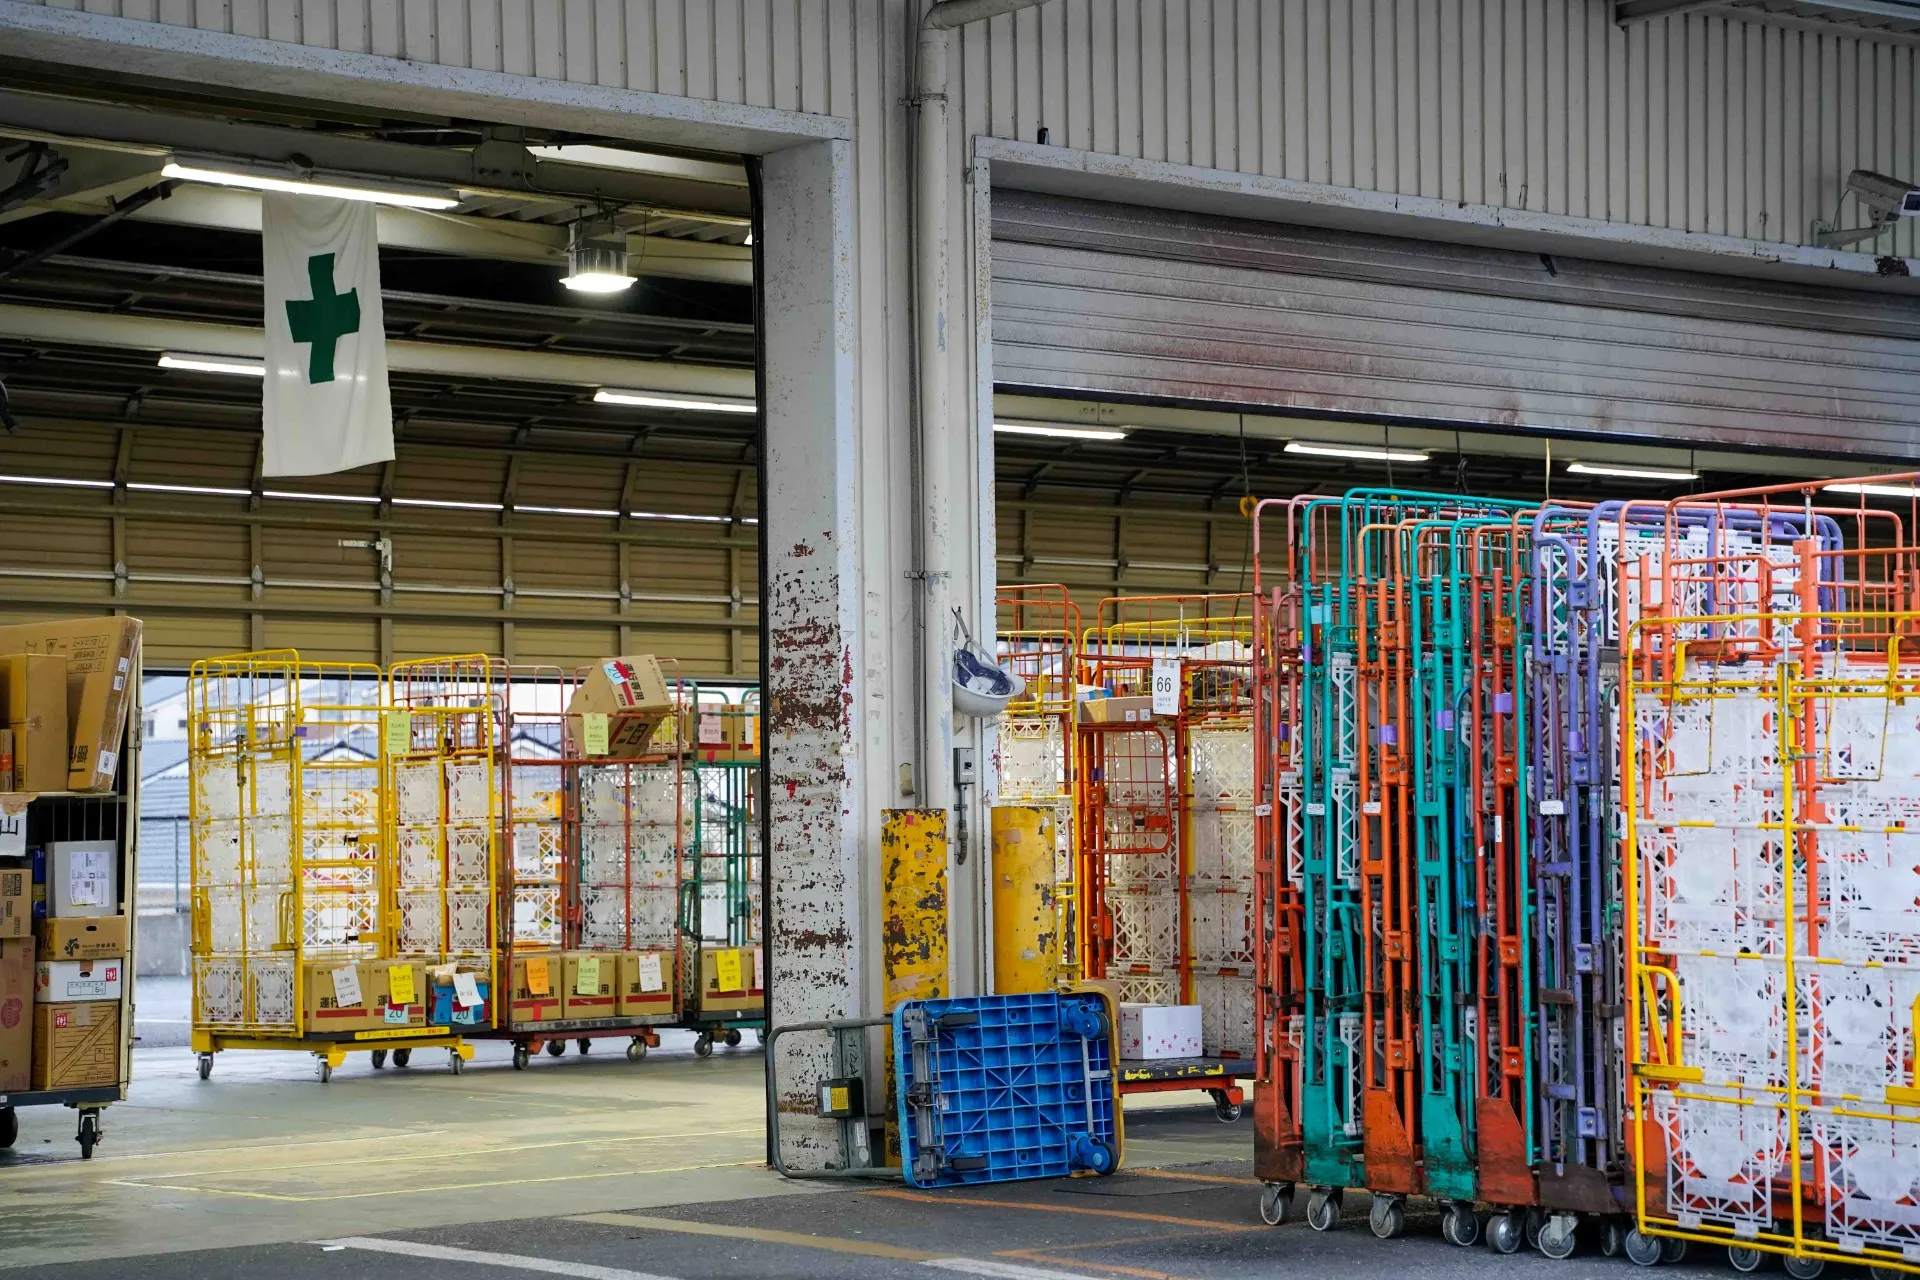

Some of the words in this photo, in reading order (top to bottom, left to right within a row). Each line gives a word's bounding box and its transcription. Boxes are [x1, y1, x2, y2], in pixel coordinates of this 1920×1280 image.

[1156, 676, 1172, 693] 66
[389, 1009, 403, 1018] 20
[456, 1010, 469, 1020] 20
